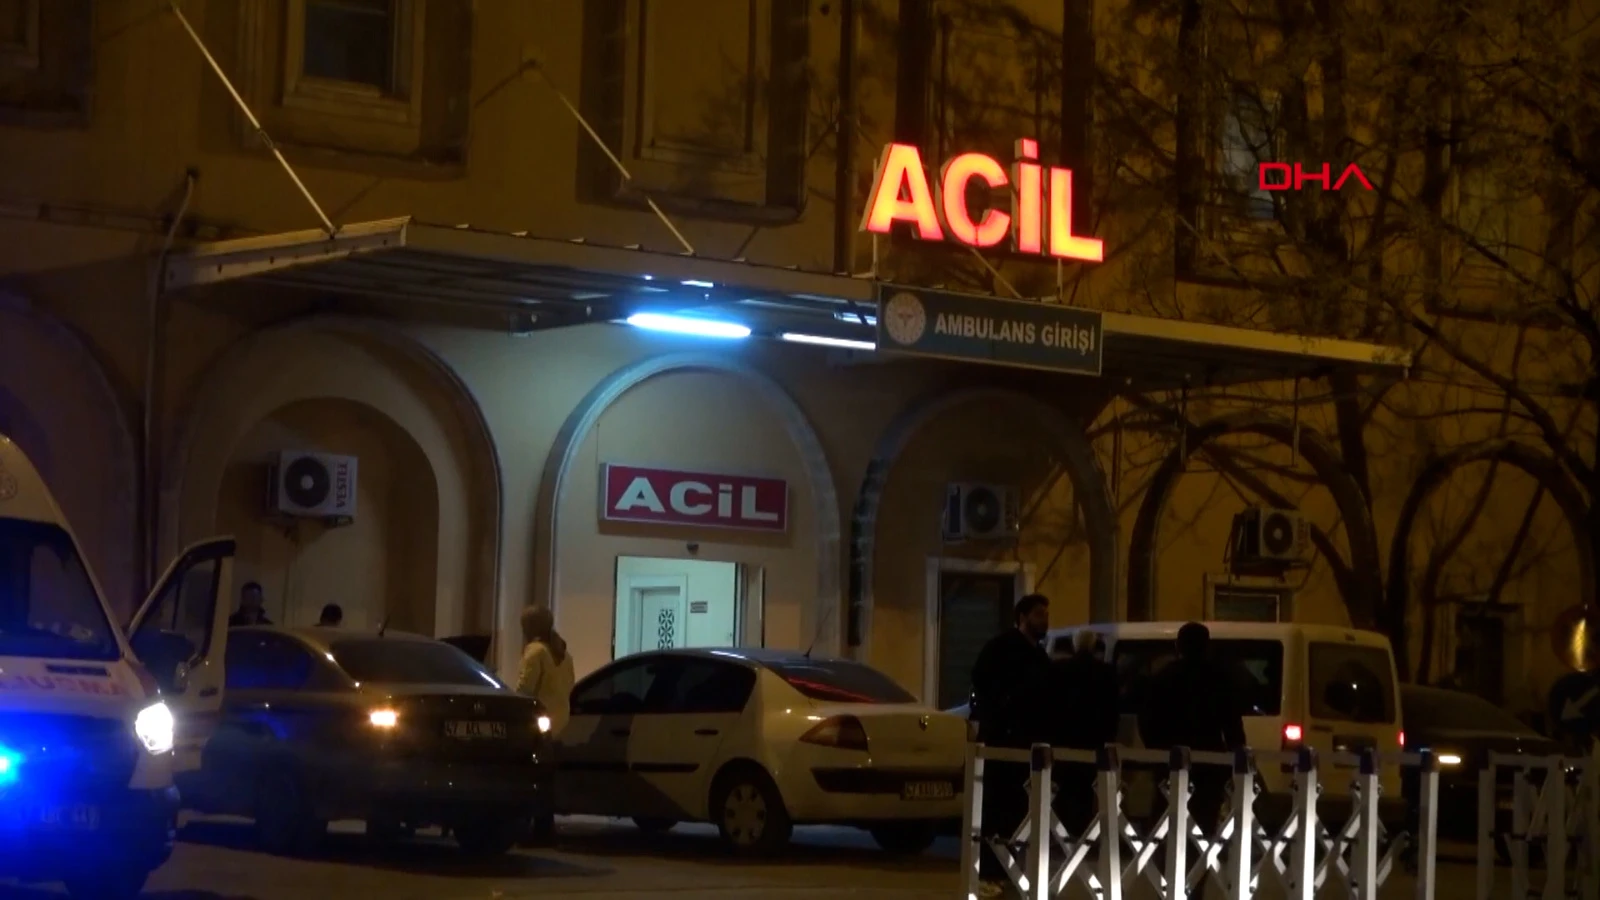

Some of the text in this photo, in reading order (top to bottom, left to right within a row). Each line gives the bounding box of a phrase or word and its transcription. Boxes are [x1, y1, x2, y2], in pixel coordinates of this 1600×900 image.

[864, 138, 1104, 262] ACİL
[934, 312, 1036, 345] AMBULANS
[1040, 321, 1096, 356] GİRİŞİ
